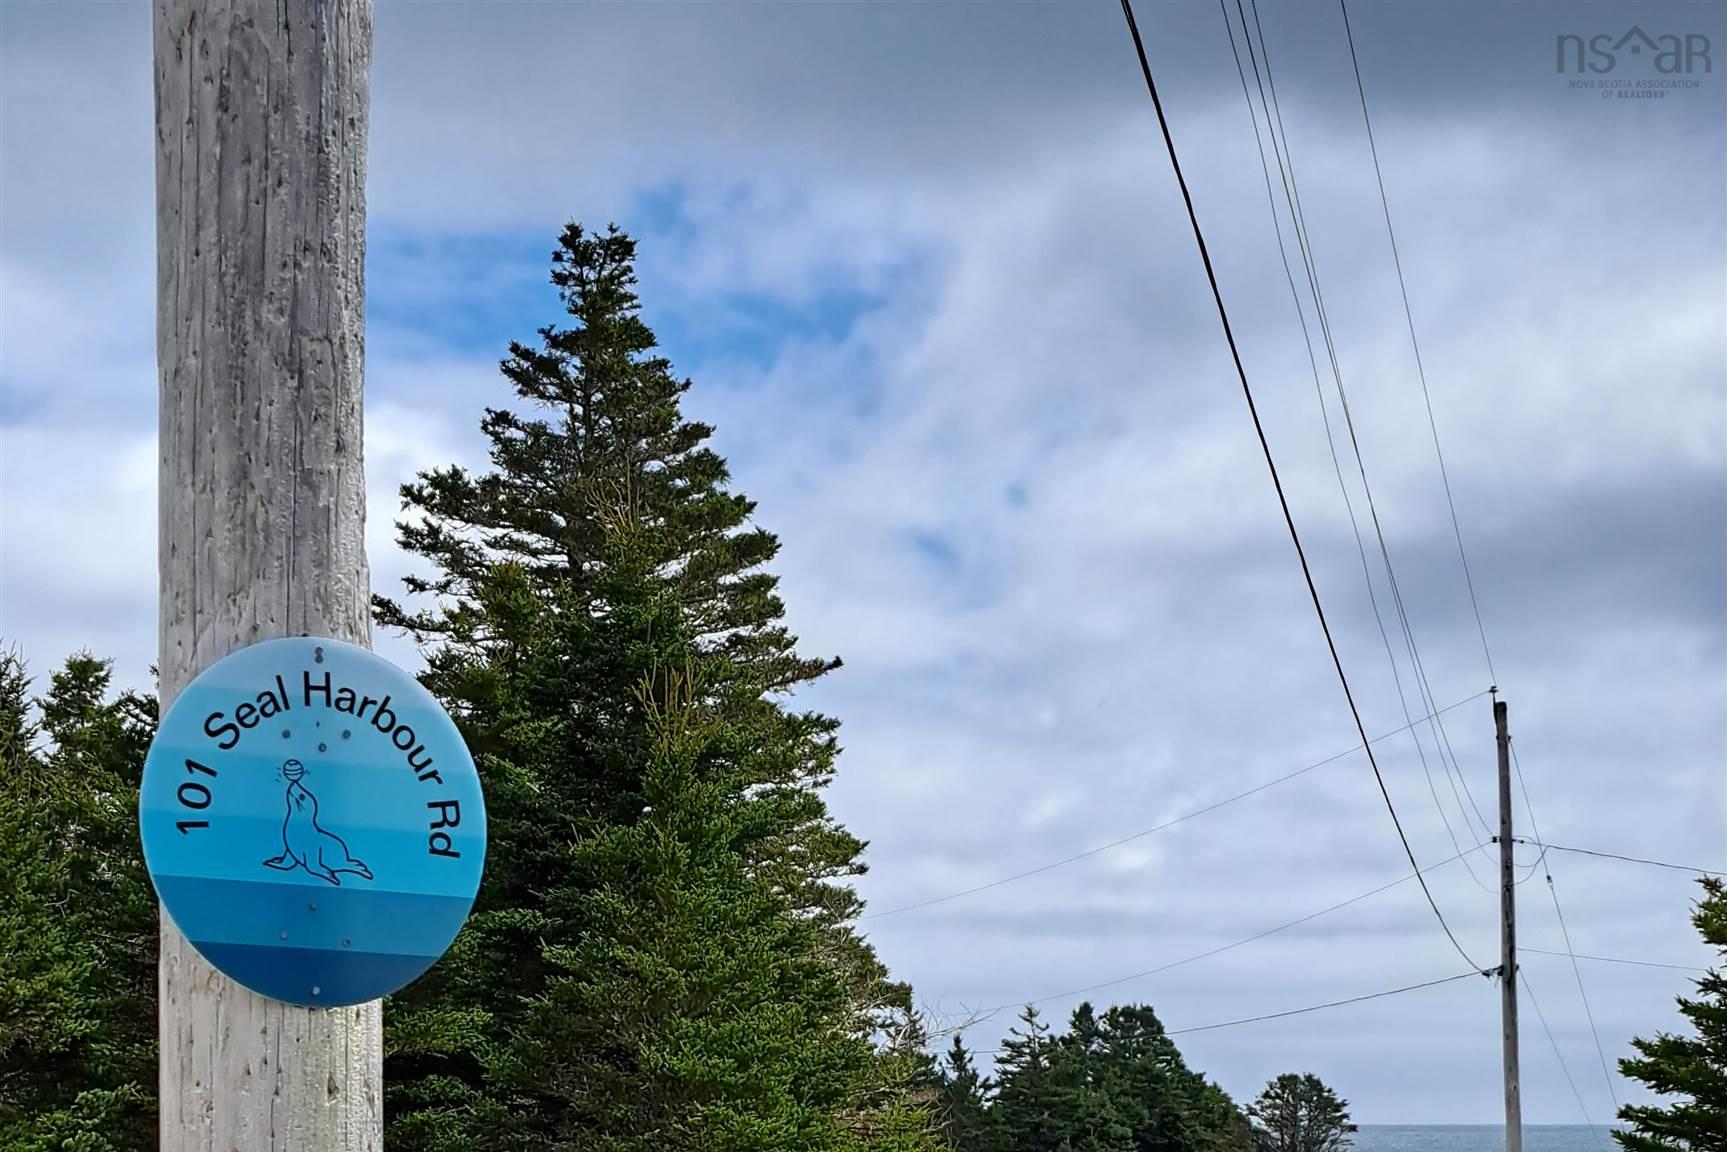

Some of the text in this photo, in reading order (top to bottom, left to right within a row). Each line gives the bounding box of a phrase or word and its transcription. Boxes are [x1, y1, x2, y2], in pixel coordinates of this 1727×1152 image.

[176, 671, 461, 859] 101 Seal Harbour Rd
